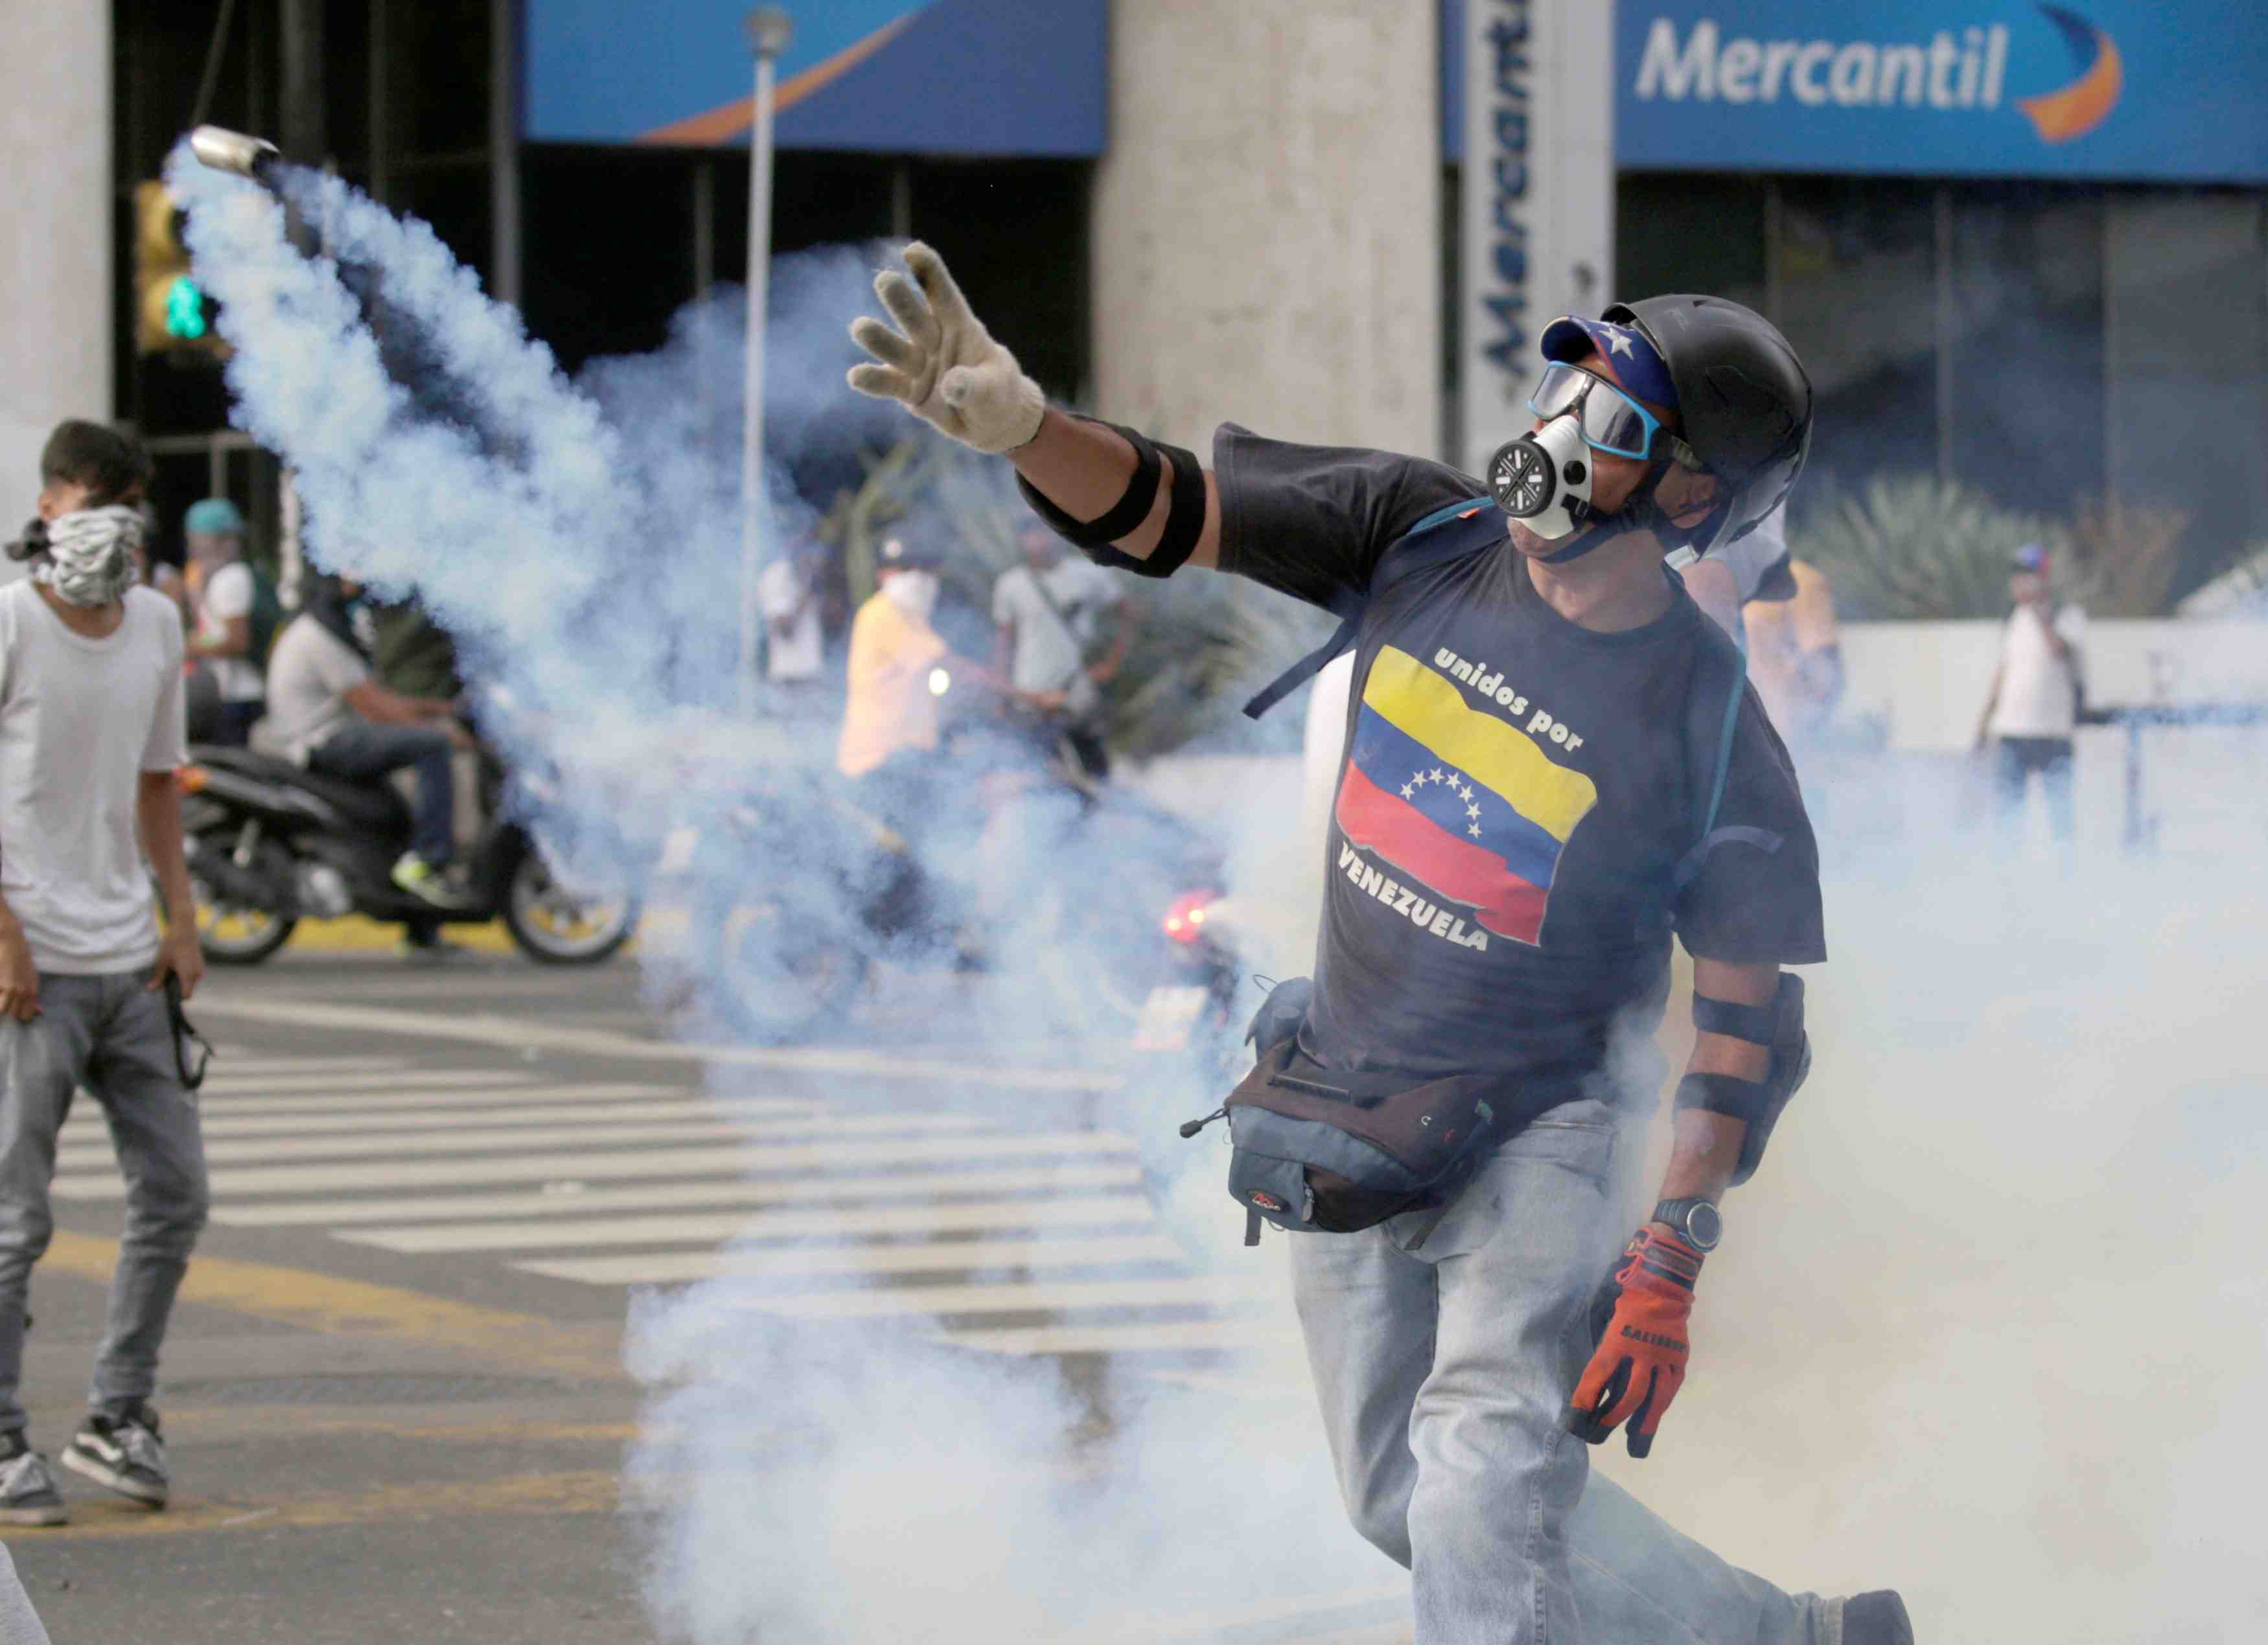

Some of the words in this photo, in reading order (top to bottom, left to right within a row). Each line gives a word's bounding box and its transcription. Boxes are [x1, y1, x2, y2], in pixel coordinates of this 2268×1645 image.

[1635, 16, 2008, 110] Mercantil
[1482, 0, 1531, 377] Mercant
[1434, 648, 1529, 715] unidos
[1527, 710, 1584, 752] por
[1337, 842, 1488, 951] VENEZUELA
